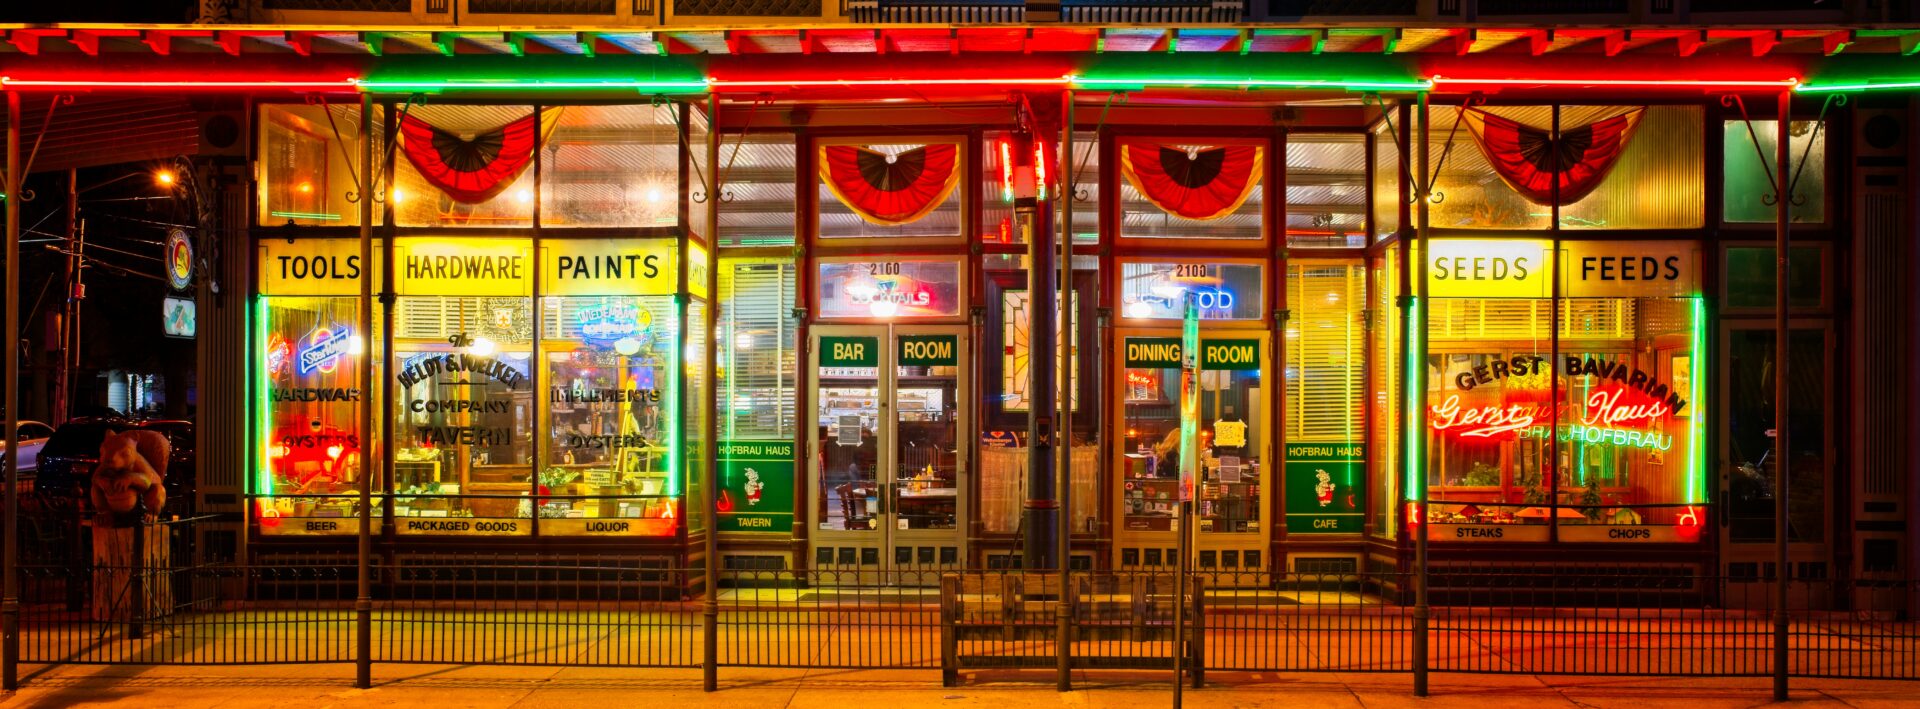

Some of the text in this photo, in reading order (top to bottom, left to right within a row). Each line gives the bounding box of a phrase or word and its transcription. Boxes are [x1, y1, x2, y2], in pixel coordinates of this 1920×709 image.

[278, 255, 360, 279] TOOLS
[406, 255, 522, 279] HARDWARE
[558, 254, 659, 279] PAINTS
[870, 262, 900, 276] 2100
[1176, 264, 1207, 278] 2100
[1434, 256, 1528, 281] SEEDS
[1582, 255, 1679, 281] FEEDS
[448, 332, 475, 347] The
[833, 341, 951, 360] BAR ROOM
[1128, 344, 1181, 361] DINING
[1207, 346, 1253, 363] ROOM
[397, 353, 524, 390] HELDT & VOELKER
[1455, 355, 1687, 415] GERST BAVARIAN
[269, 388, 361, 402] HARDWAR
[550, 389, 661, 403] IMPLEMENTS
[410, 399, 511, 414] COMPANY
[1432, 388, 1668, 435] Gerst Haus
[417, 427, 511, 446] TAVERN
[570, 434, 647, 449] OYSTERS
[1570, 424, 1672, 451] HOFBRAU
[718, 446, 791, 455] HOFBRAU HAUS
[1289, 447, 1362, 457] HOFBRAU HAUS
[306, 521, 337, 531] BEER
[408, 521, 518, 532] PACKAGED GOODS
[586, 522, 629, 532] LIQUOR
[737, 517, 772, 527] TAVERN
[1313, 519, 1338, 529] CAFE
[1456, 527, 1503, 538] STEAKS
[1608, 529, 1650, 539] CHOPS
